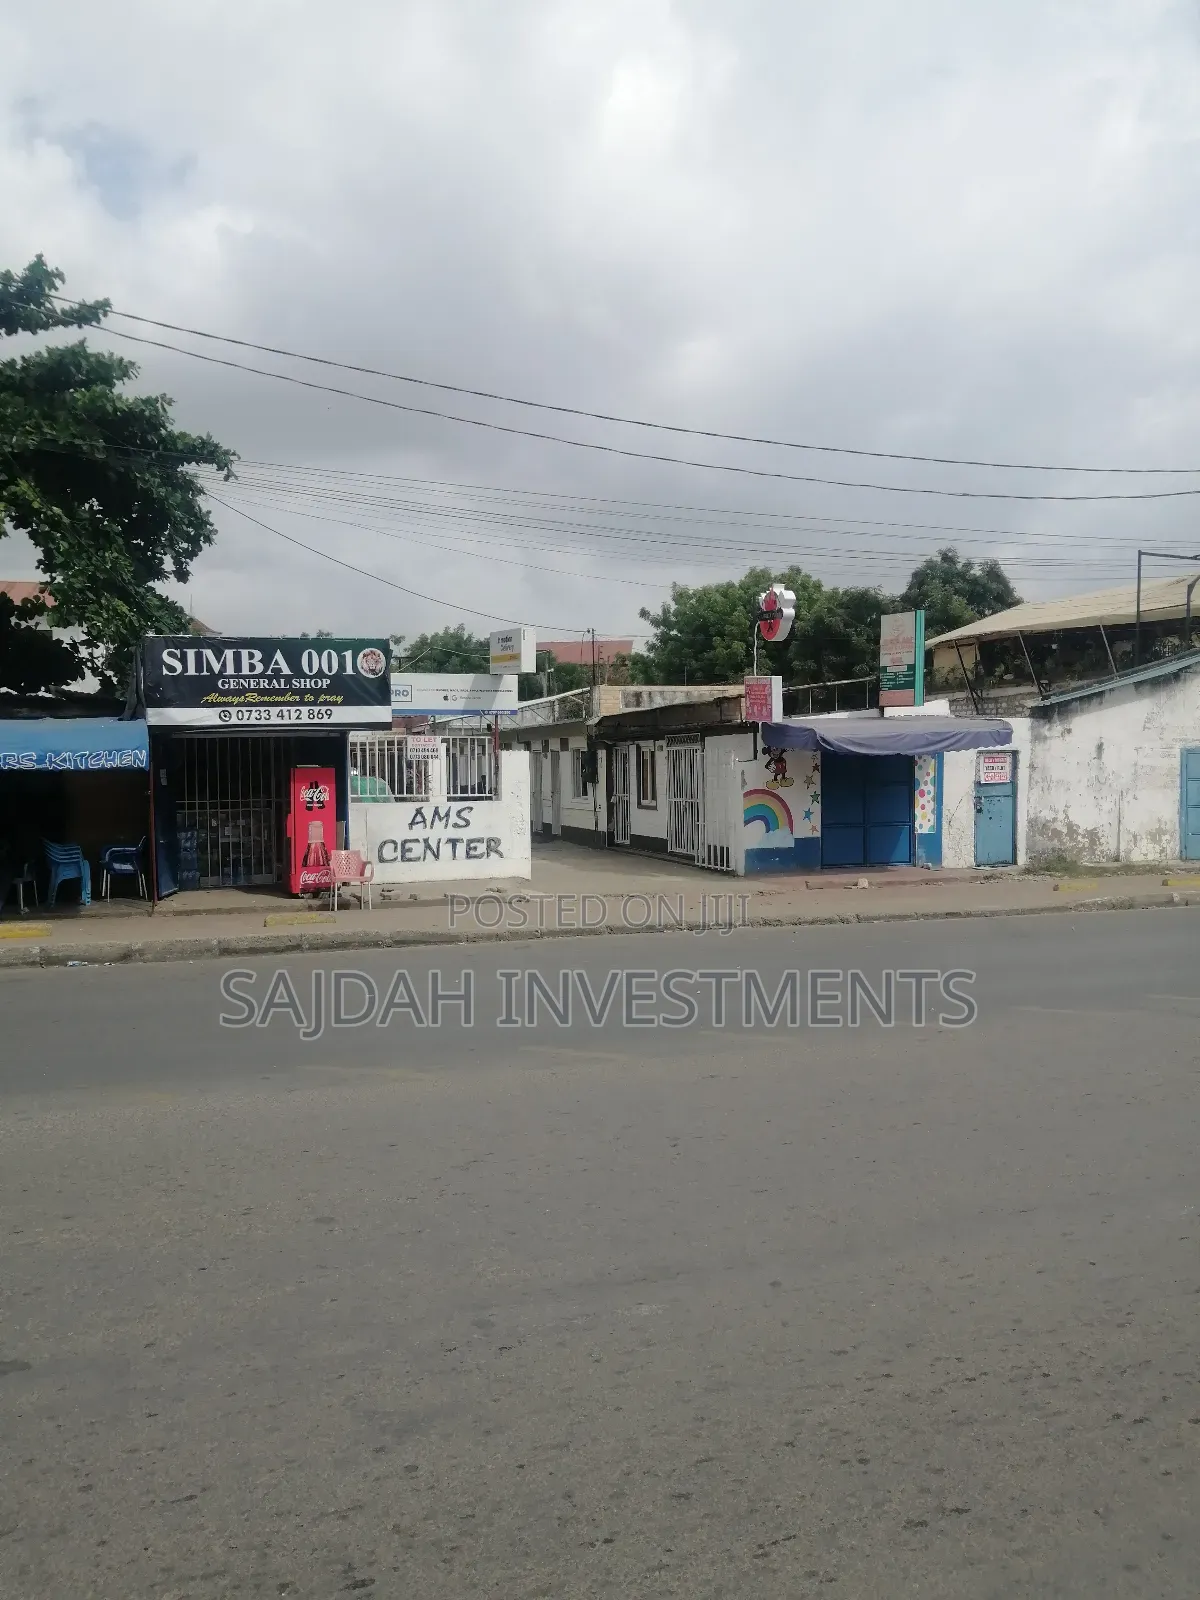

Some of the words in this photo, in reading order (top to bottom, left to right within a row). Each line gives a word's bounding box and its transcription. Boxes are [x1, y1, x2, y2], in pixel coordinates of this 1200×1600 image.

[161, 648, 294, 676] SIMBA
[301, 649, 357, 676] 001
[217, 678, 290, 690] GENERAL
[292, 678, 331, 690] SHOP
[303, 693, 315, 702] to
[317, 693, 344, 704] pray
[236, 709, 271, 721] 0733
[276, 709, 303, 721] 412
[307, 709, 333, 721] 869
[0, 752, 37, 770] RS
[45, 750, 147, 769] KITCHEN
[407, 806, 474, 831] AMS
[377, 837, 505, 864] CENTER
